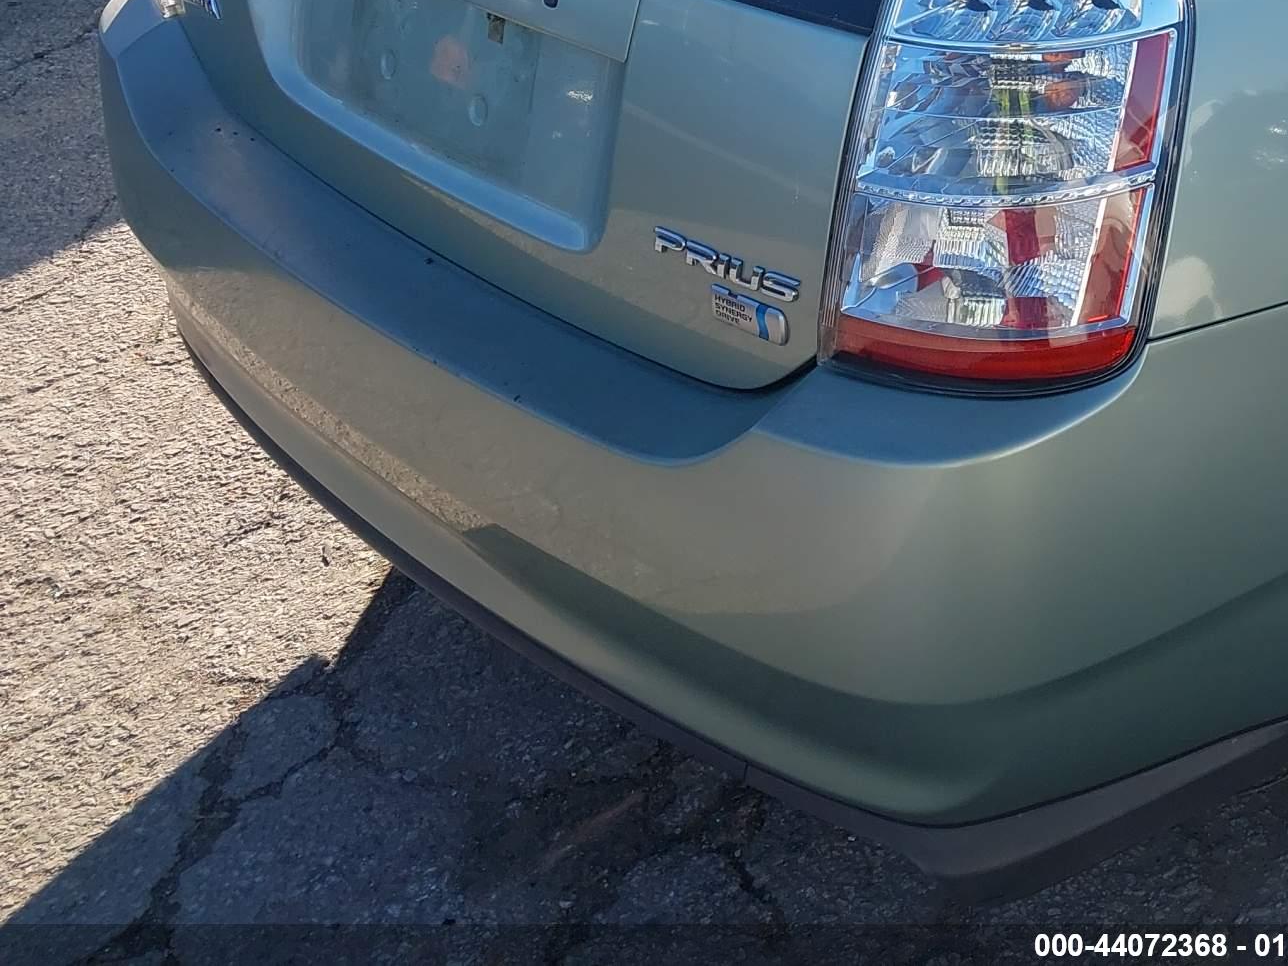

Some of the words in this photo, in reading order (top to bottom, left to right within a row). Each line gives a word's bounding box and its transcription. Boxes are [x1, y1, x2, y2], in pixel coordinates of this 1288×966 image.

[653, 225, 801, 303] PRIUS
[713, 294, 746, 313] HYBRID
[714, 302, 753, 323] SYNERGY
[715, 309, 741, 325] DRIVE
